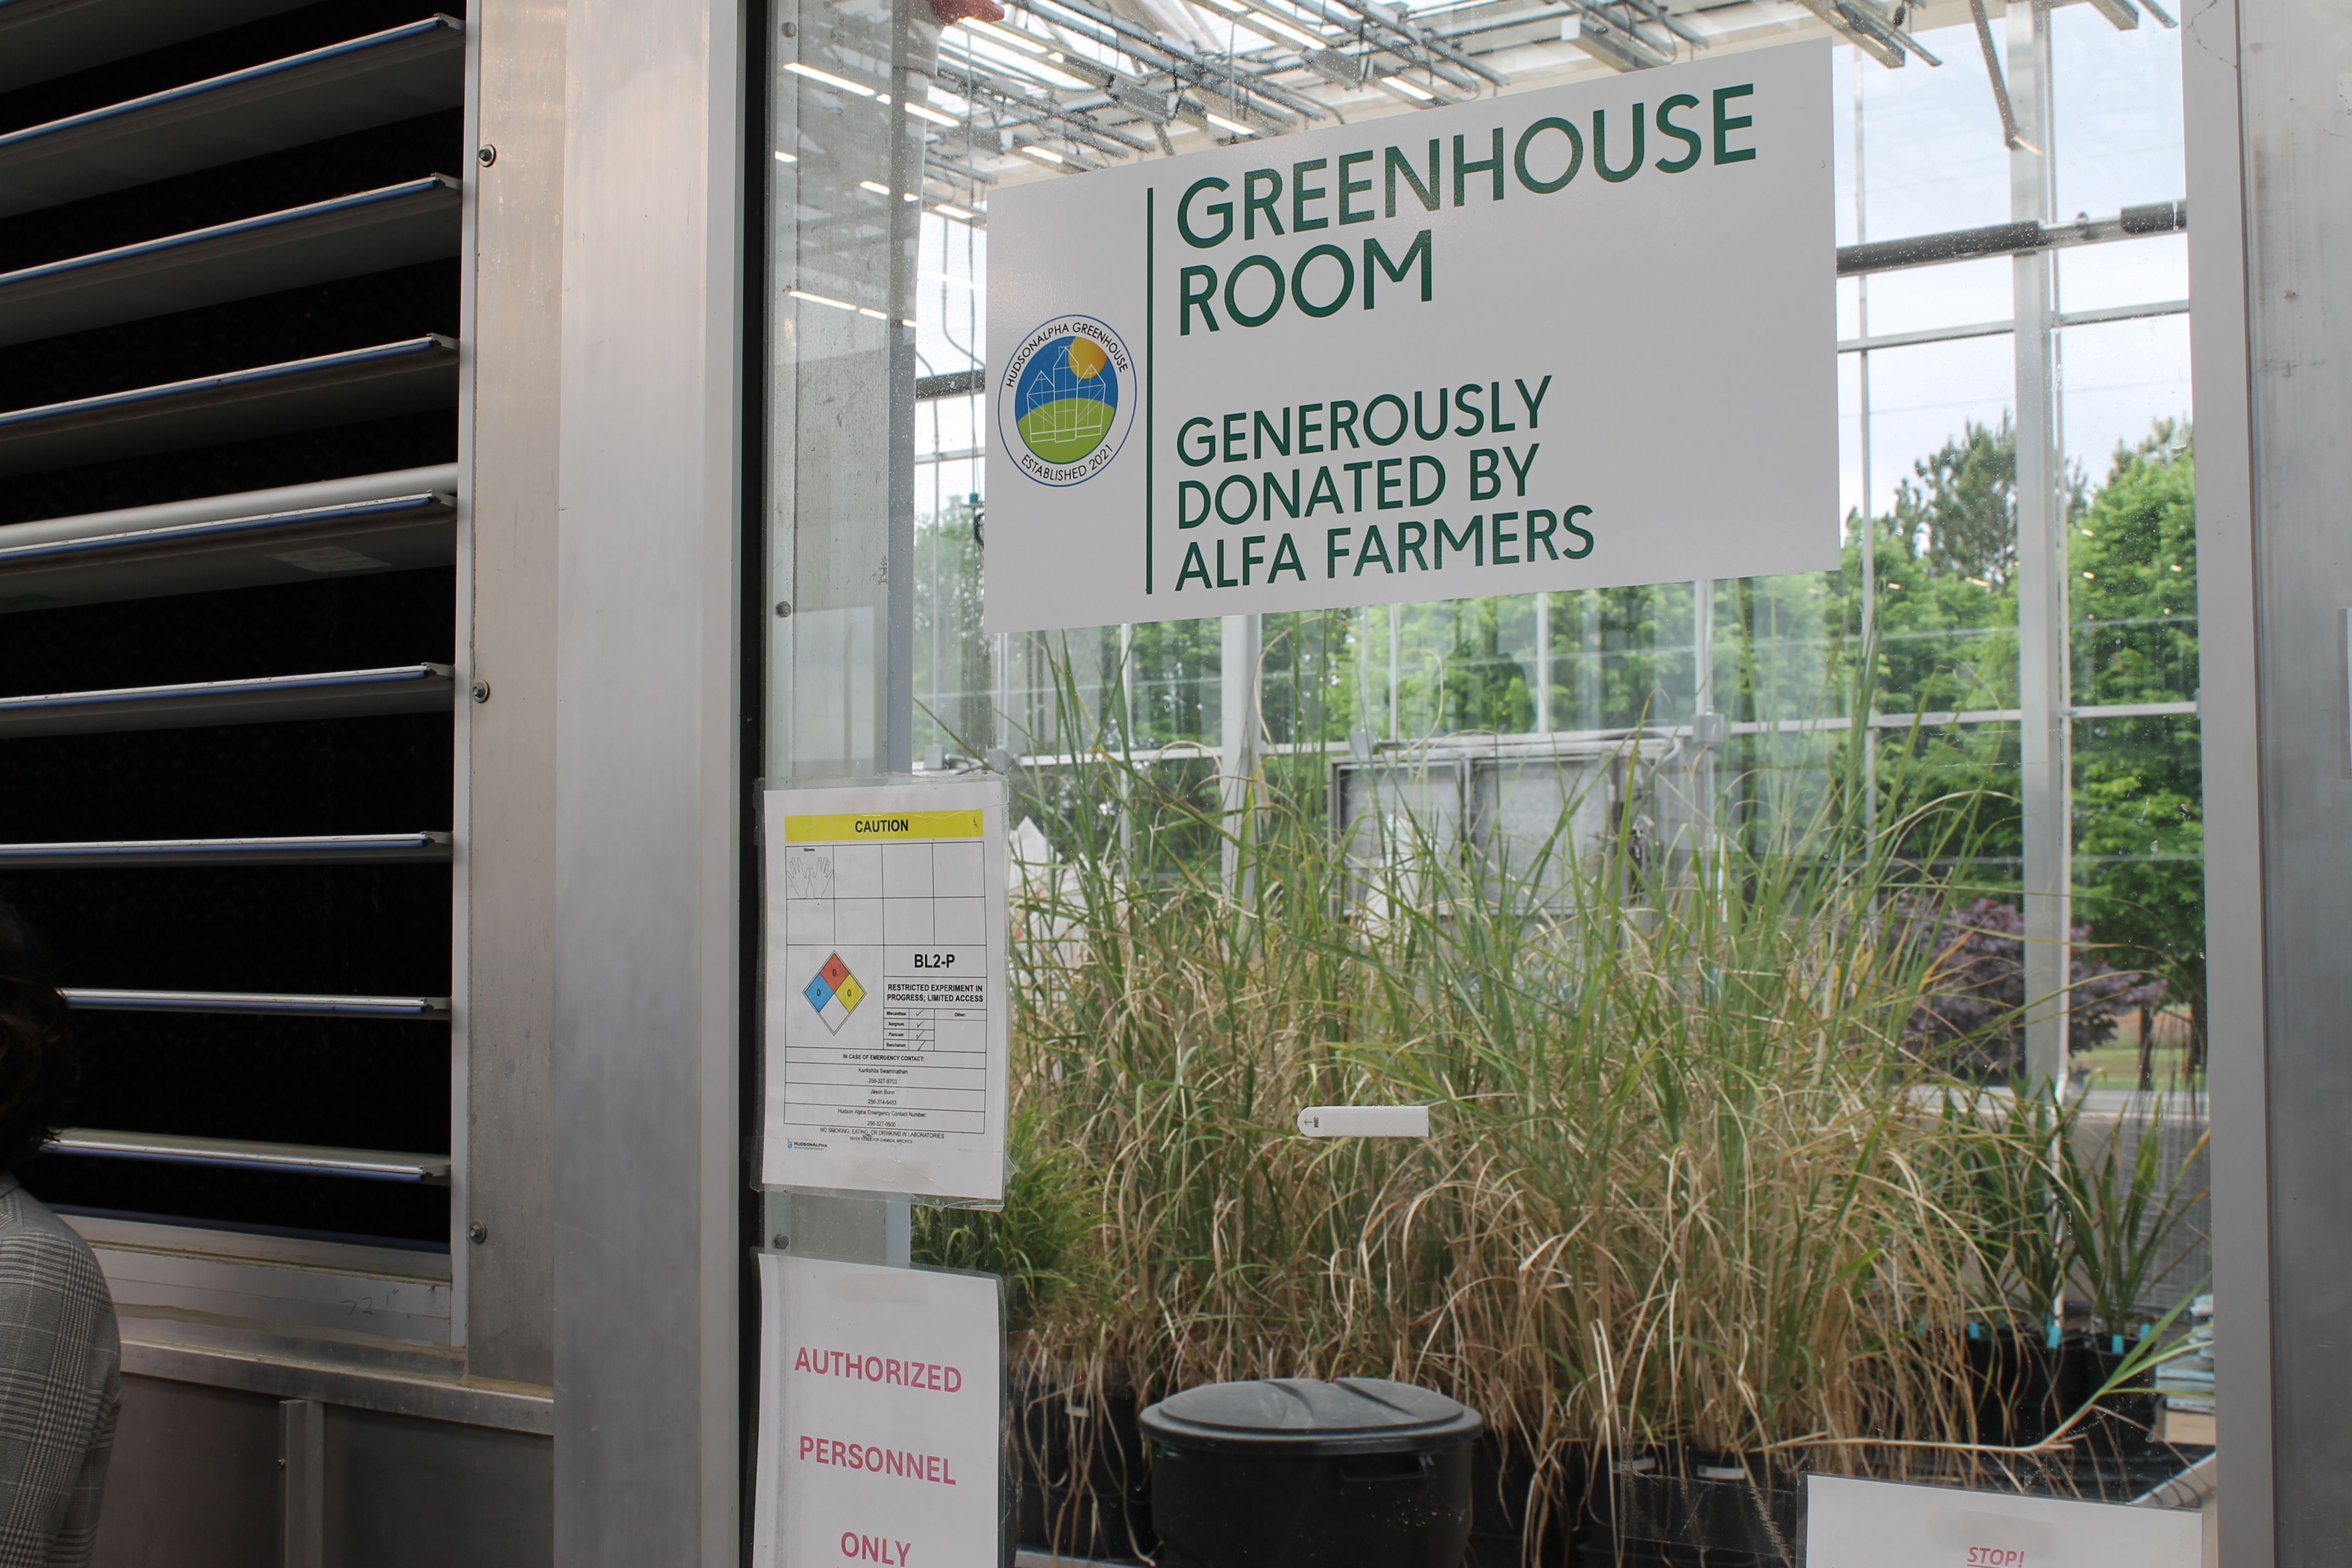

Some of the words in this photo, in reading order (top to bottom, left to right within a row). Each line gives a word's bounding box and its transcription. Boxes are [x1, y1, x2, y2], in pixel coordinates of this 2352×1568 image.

[1177, 83, 1757, 249] GREENHOUSE
[1179, 228, 1433, 336] ROOM
[1005, 323, 1069, 388] HUDSONALPHA
[1072, 322, 1129, 373] GREENHOUSE
[1177, 375, 1553, 467] GENEROUSLY
[1020, 454, 1087, 481] ESTABLISHED
[1088, 443, 1113, 471] 2021
[1178, 455, 1446, 530] DONATED
[1469, 442, 1540, 502] BY
[1174, 532, 1306, 592] ALFA
[1327, 504, 1594, 579] FARMERS
[854, 819, 909, 833] CAUTION
[832, 968, 836, 977] 0
[914, 954, 955, 968] BL2-P
[816, 989, 821, 997] 0
[847, 989, 852, 997] 0
[887, 994, 926, 1003] PROGRESS;
[794, 1347, 962, 1393] AUTHORIZED
[799, 1435, 956, 1485] PERSONNEL
[841, 1532, 912, 1568] ONLY
[1966, 1546, 2025, 1568] STOP!
